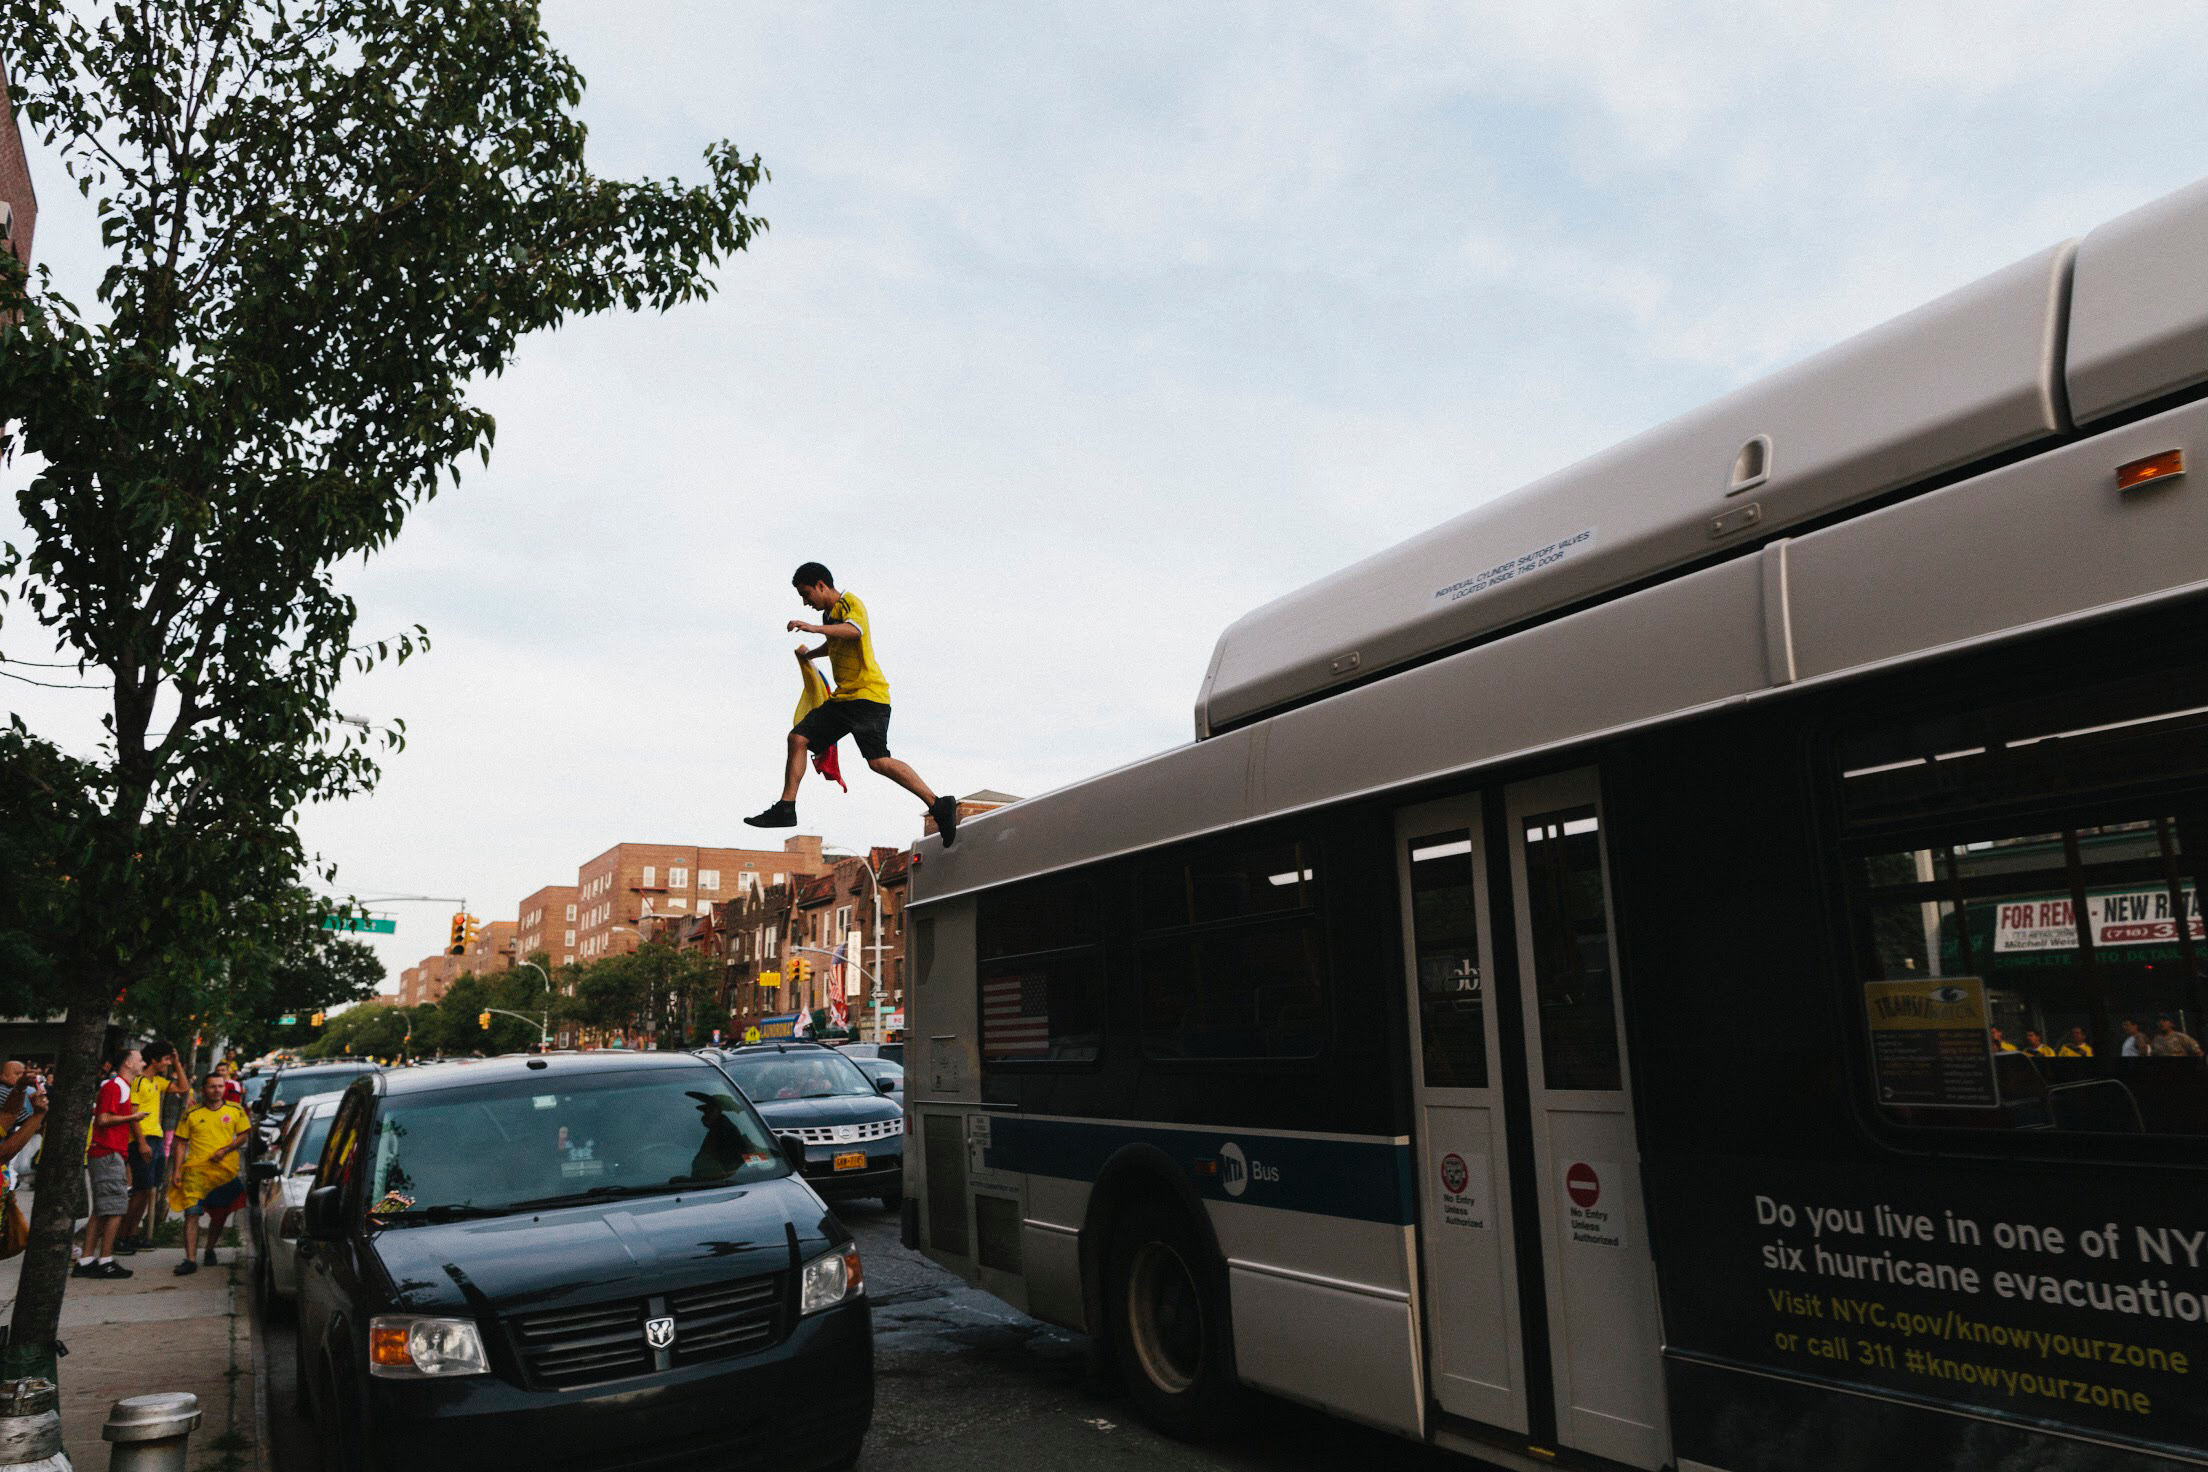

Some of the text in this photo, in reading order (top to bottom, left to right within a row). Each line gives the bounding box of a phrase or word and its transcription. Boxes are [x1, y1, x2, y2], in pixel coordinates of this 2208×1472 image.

[1435, 531, 1590, 598] INDIVIDUAL CYLINDER SHUTOFF VALVES
[1452, 551, 1565, 600] LOCATED INSIDE THIS DOOR
[2001, 905, 2033, 930] FOR
[2040, 902, 2076, 927] REN
[2104, 895, 2149, 923] NEW
[1252, 1160, 1280, 1182] Bus
[1444, 1205, 1468, 1216] Unless
[1456, 1195, 1475, 1207] Entry
[1570, 1207, 1608, 1222] No Entry
[1446, 1216, 1483, 1229] Authorized
[1571, 1220, 1600, 1232] Unless
[1755, 1195, 2208, 1268] Do you live in one of NY
[1573, 1233, 1619, 1247] Authorized
[1762, 1239, 1806, 1273] six
[1814, 1242, 1981, 1294] hurricane
[1767, 1288, 2190, 1375] Visit NYC.gov/knowyourzone
[1775, 1331, 2151, 1415] or call 311 #knowyourzone
